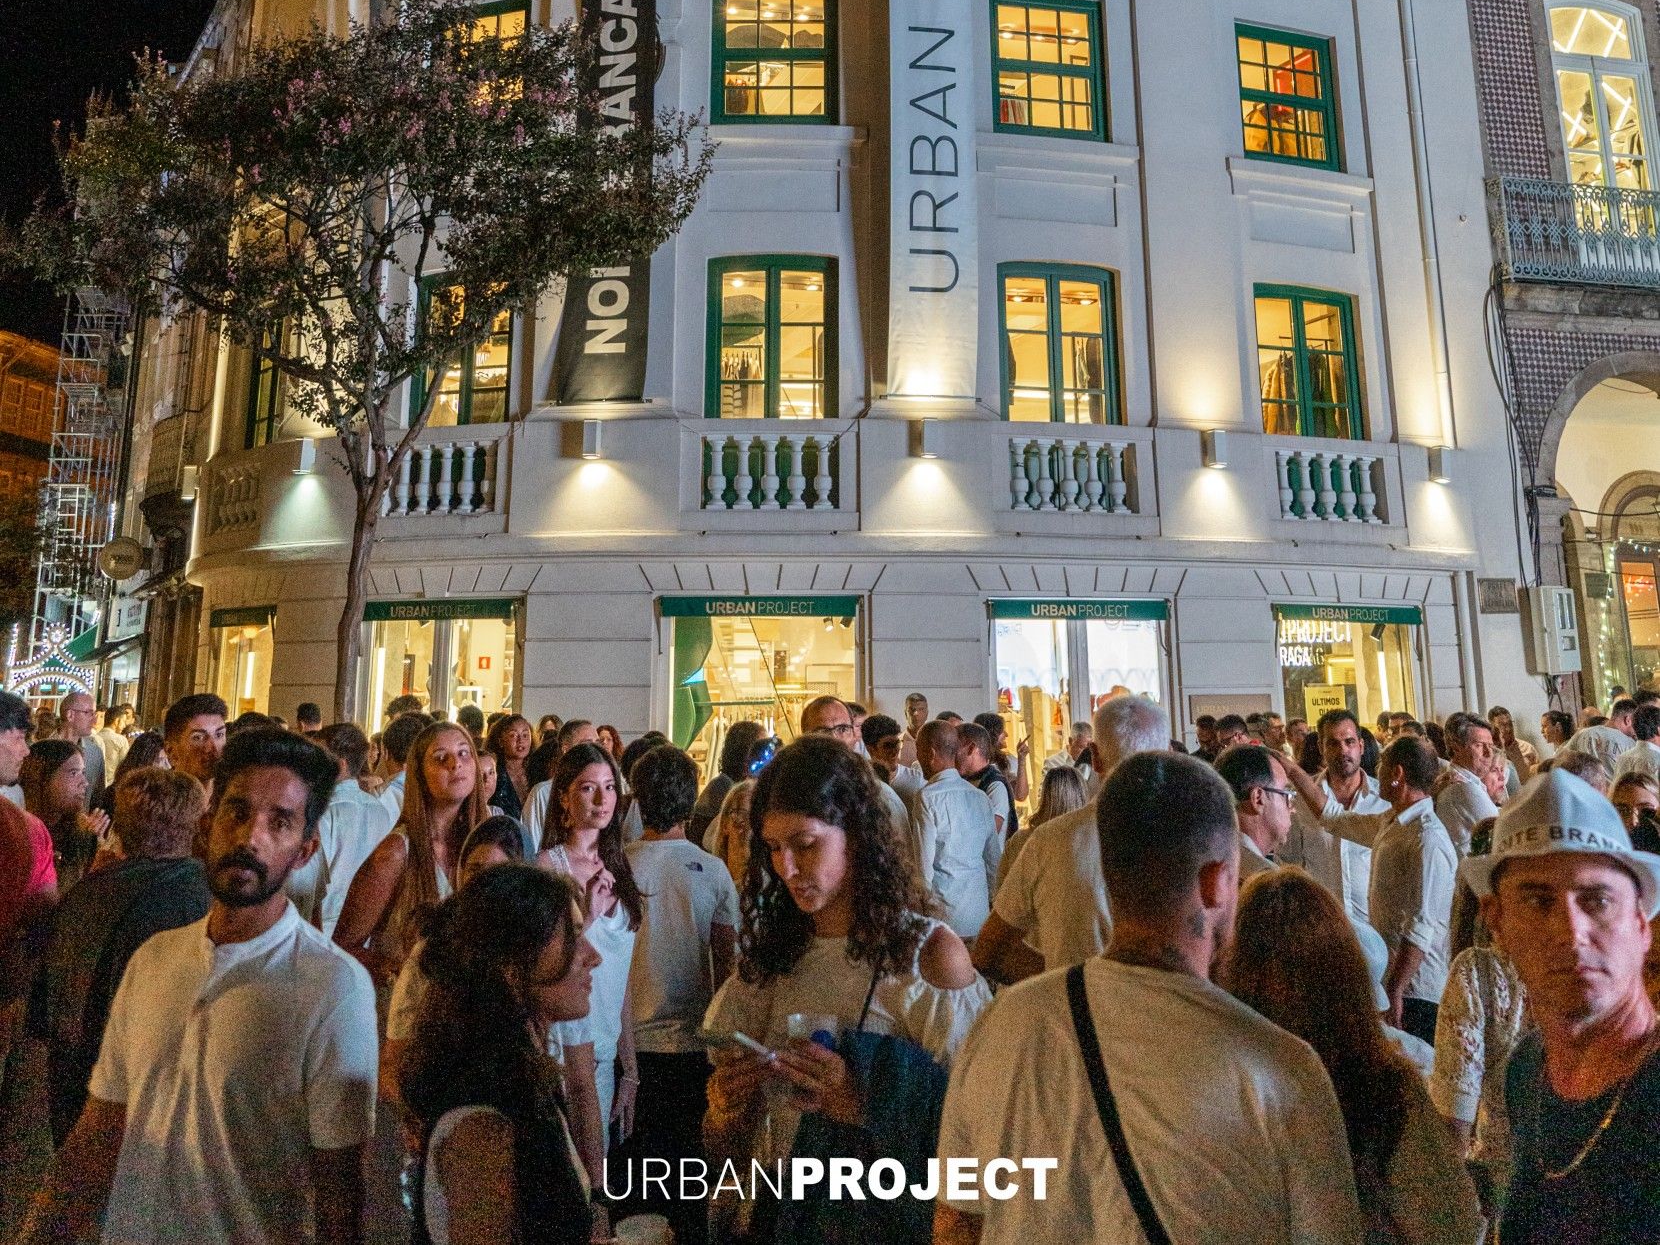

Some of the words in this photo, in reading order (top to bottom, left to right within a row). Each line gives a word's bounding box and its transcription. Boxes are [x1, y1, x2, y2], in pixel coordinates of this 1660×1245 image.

[908, 25, 959, 293] URBAN
[584, 265, 632, 354] NOI
[1279, 645, 1312, 666] RAGA
[1311, 697, 1341, 707] ULTIMOS
